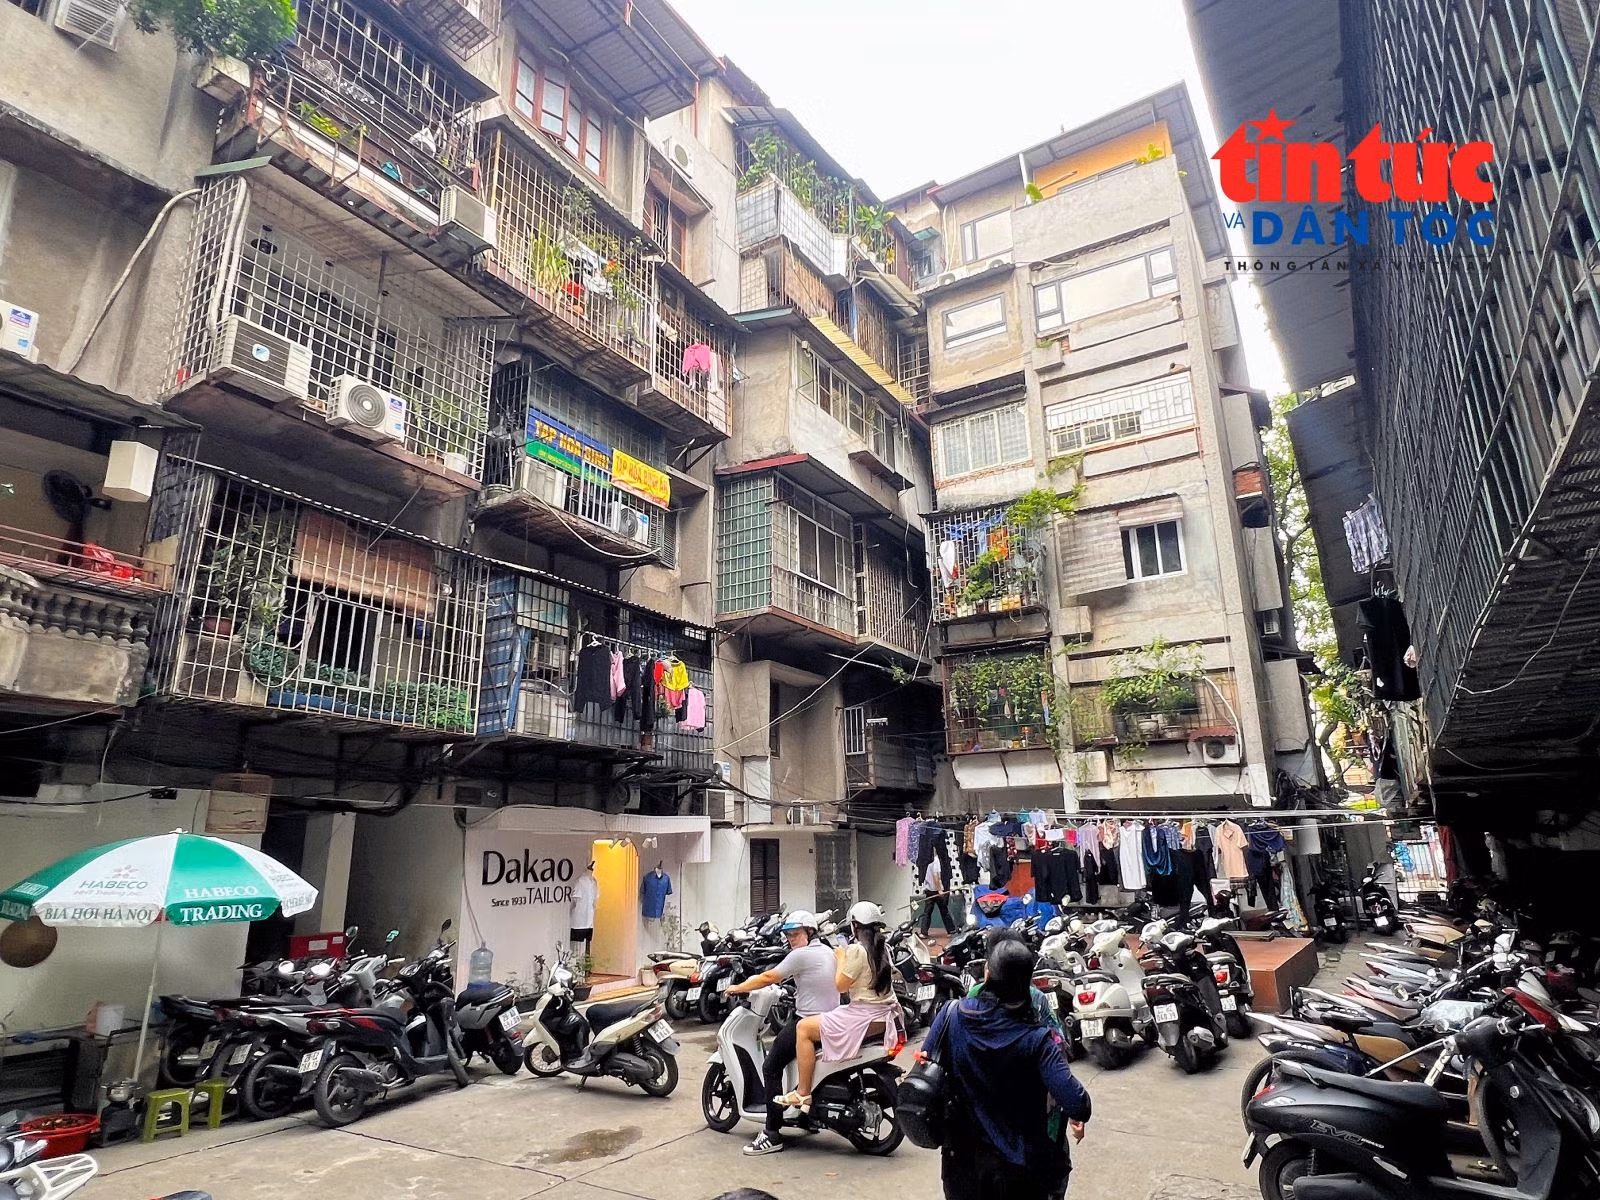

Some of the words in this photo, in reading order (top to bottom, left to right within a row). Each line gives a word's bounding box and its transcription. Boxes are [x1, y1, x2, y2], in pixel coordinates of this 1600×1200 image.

[482, 848, 574, 885] Dakao
[79, 880, 149, 890] HABECO
[184, 886, 258, 899] HABECO
[492, 899, 510, 907] Since
[511, 897, 527, 906] 1933
[44, 908, 68, 920] BIA
[71, 907, 99, 919] HƠI
[103, 905, 123, 920] HÀ
[126, 906, 152, 921] NỘI
[180, 904, 263, 922] TRADING
